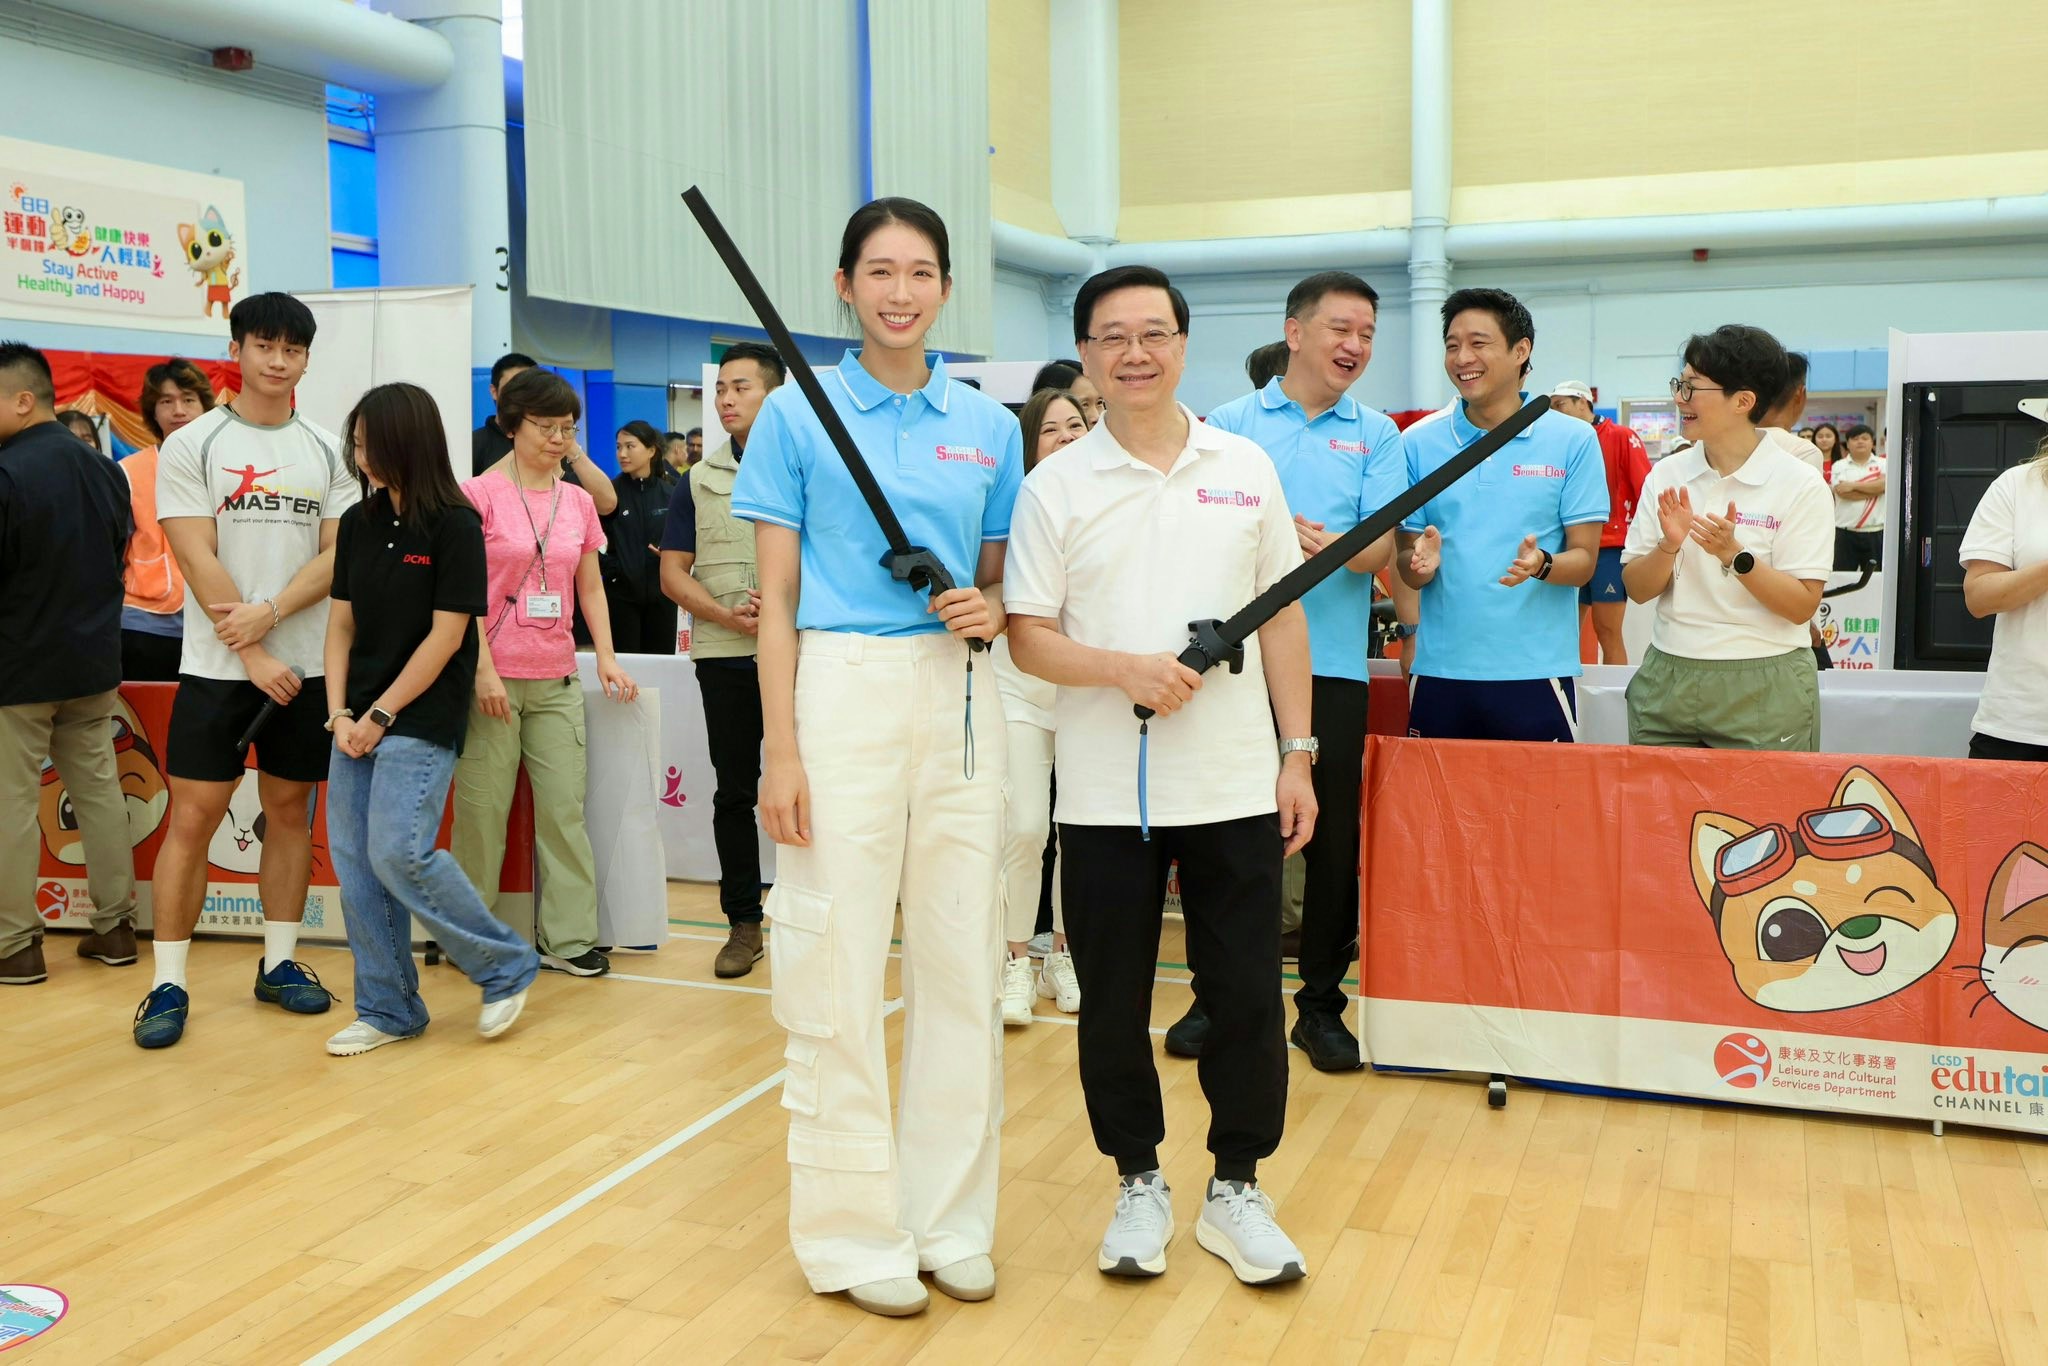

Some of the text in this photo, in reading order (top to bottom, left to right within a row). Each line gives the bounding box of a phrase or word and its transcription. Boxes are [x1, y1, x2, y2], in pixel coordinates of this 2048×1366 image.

[21, 197, 49, 214] 日日
[5, 212, 46, 237] 運動
[95, 227, 150, 247] 健康快樂
[101, 246, 151, 268] 人輕鬆
[42, 259, 119, 281] Stay Active
[495, 247, 510, 291] 3
[18, 275, 145, 304] Healthy and Happy
[936, 446, 968, 462] SPORT
[976, 448, 996, 468] DAY
[224, 495, 320, 516] MASTER
[1197, 489, 1229, 504] SPORT
[1235, 491, 1261, 506] DAY
[1844, 618, 1880, 634] 健康
[1849, 636, 1872, 656] 人
[1778, 1046, 1897, 1070] 康樂及文化事務署
[1931, 1054, 1962, 1067] LCSD
[1778, 1063, 1897, 1086] Leisure and Cultural
[1772, 1076, 1897, 1100] Services Department
[1933, 1095, 2022, 1114] CHANNEL
[2029, 1102, 2045, 1116] 康
